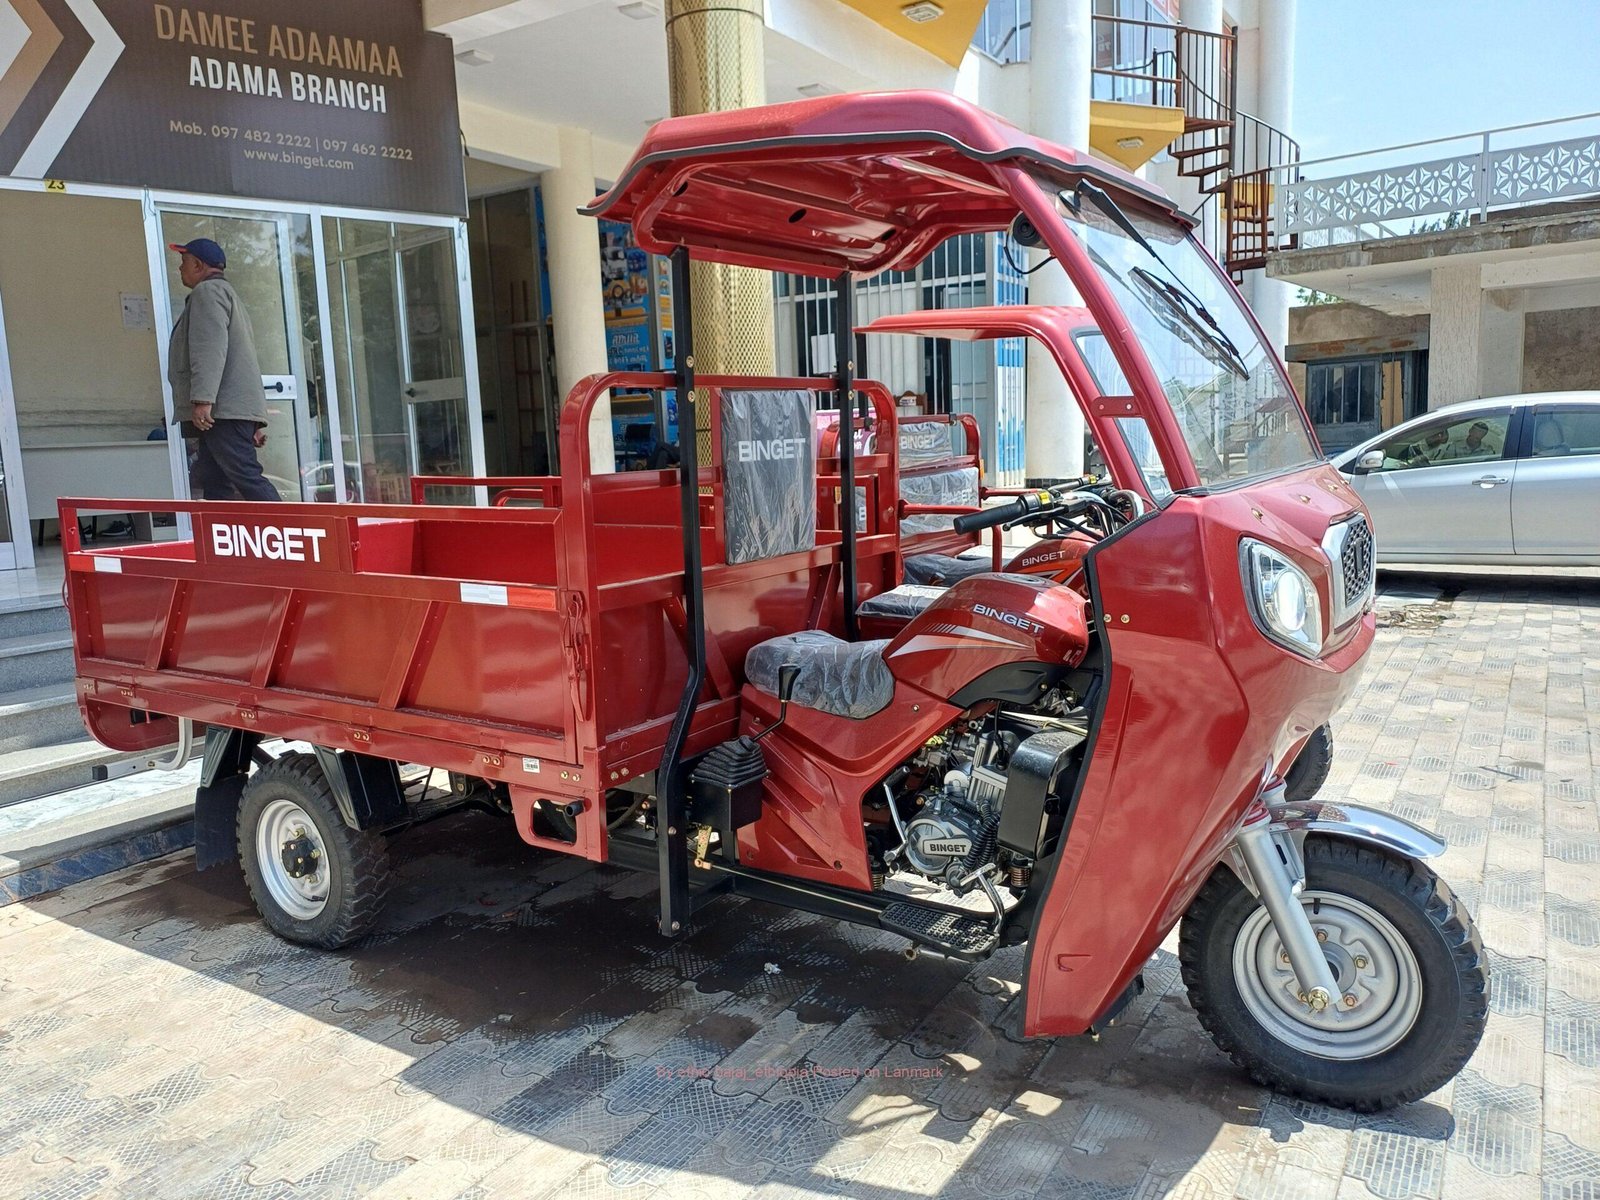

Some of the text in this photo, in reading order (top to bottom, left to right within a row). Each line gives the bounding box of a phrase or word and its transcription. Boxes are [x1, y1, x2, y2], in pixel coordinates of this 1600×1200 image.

[154, 4, 403, 78] DAMEE ADAAMAA
[189, 55, 387, 113] ADAMA BRANCH
[169, 120, 207, 136] Mob.
[211, 125, 238, 139] 097
[244, 129, 272, 144] 482
[276, 133, 312, 148] 2222
[322, 139, 347, 152] 097
[352, 142, 377, 156] 462
[380, 146, 413, 160] 2222
[243, 149, 354, 170] www.binget.com
[738, 438, 806, 461] BINGET
[901, 434, 936, 449] BINGET
[211, 523, 327, 563] BINGET
[1022, 550, 1065, 567] BINGET
[972, 603, 1045, 634] BINGET
[929, 843, 967, 853] BINGET
